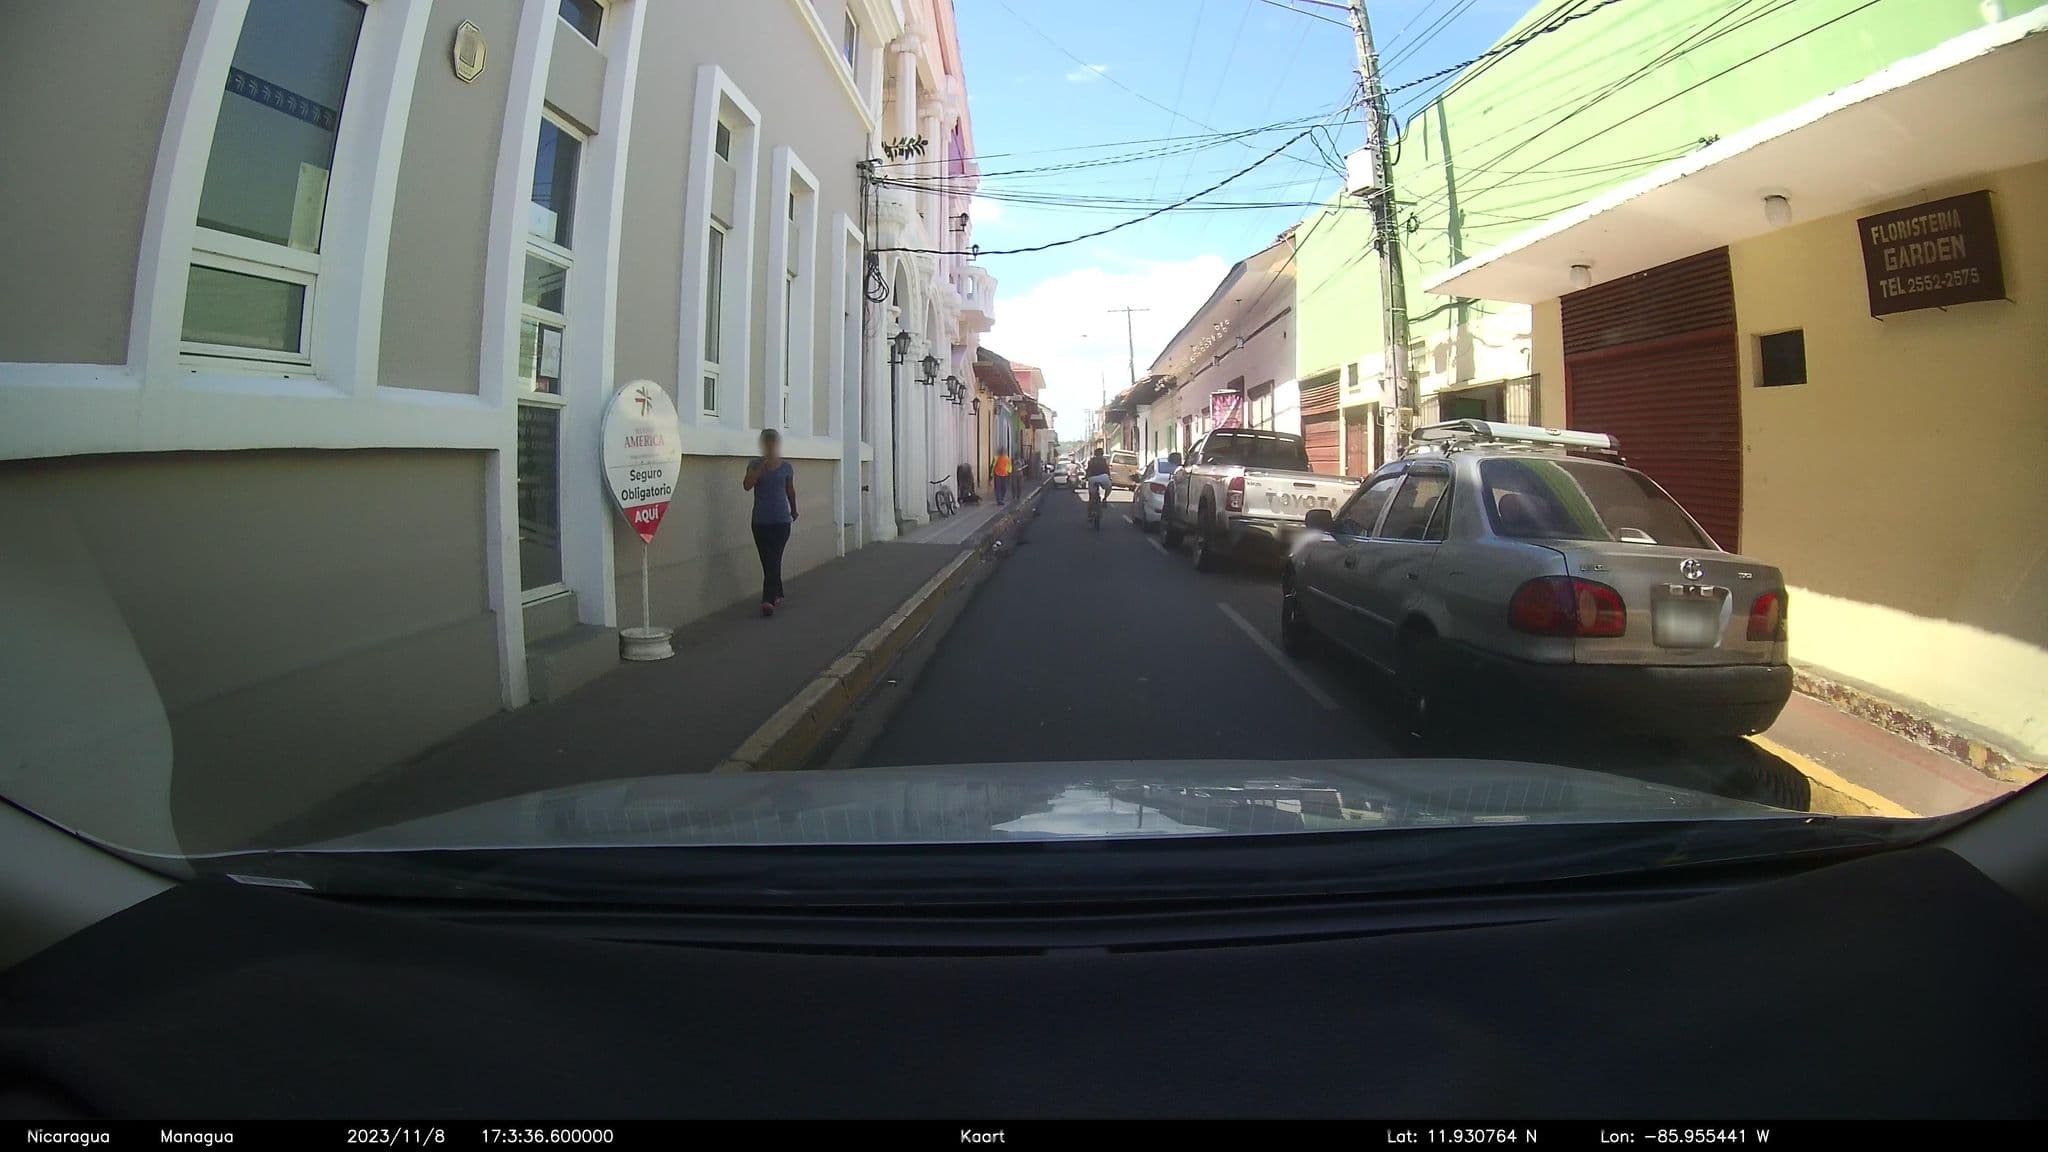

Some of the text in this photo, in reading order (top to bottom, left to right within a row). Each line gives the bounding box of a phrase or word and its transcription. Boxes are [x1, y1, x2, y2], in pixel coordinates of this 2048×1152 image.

[1870, 208, 1961, 245] FLORISTERIA
[1883, 234, 1967, 272] GARDEN
[1907, 267, 1980, 294] 2552-2575
[630, 469, 663, 482] Seguro
[621, 483, 672, 502] Obligatorio
[1265, 492, 1338, 511] TOYOTA
[635, 504, 659, 524] AQUÍ
